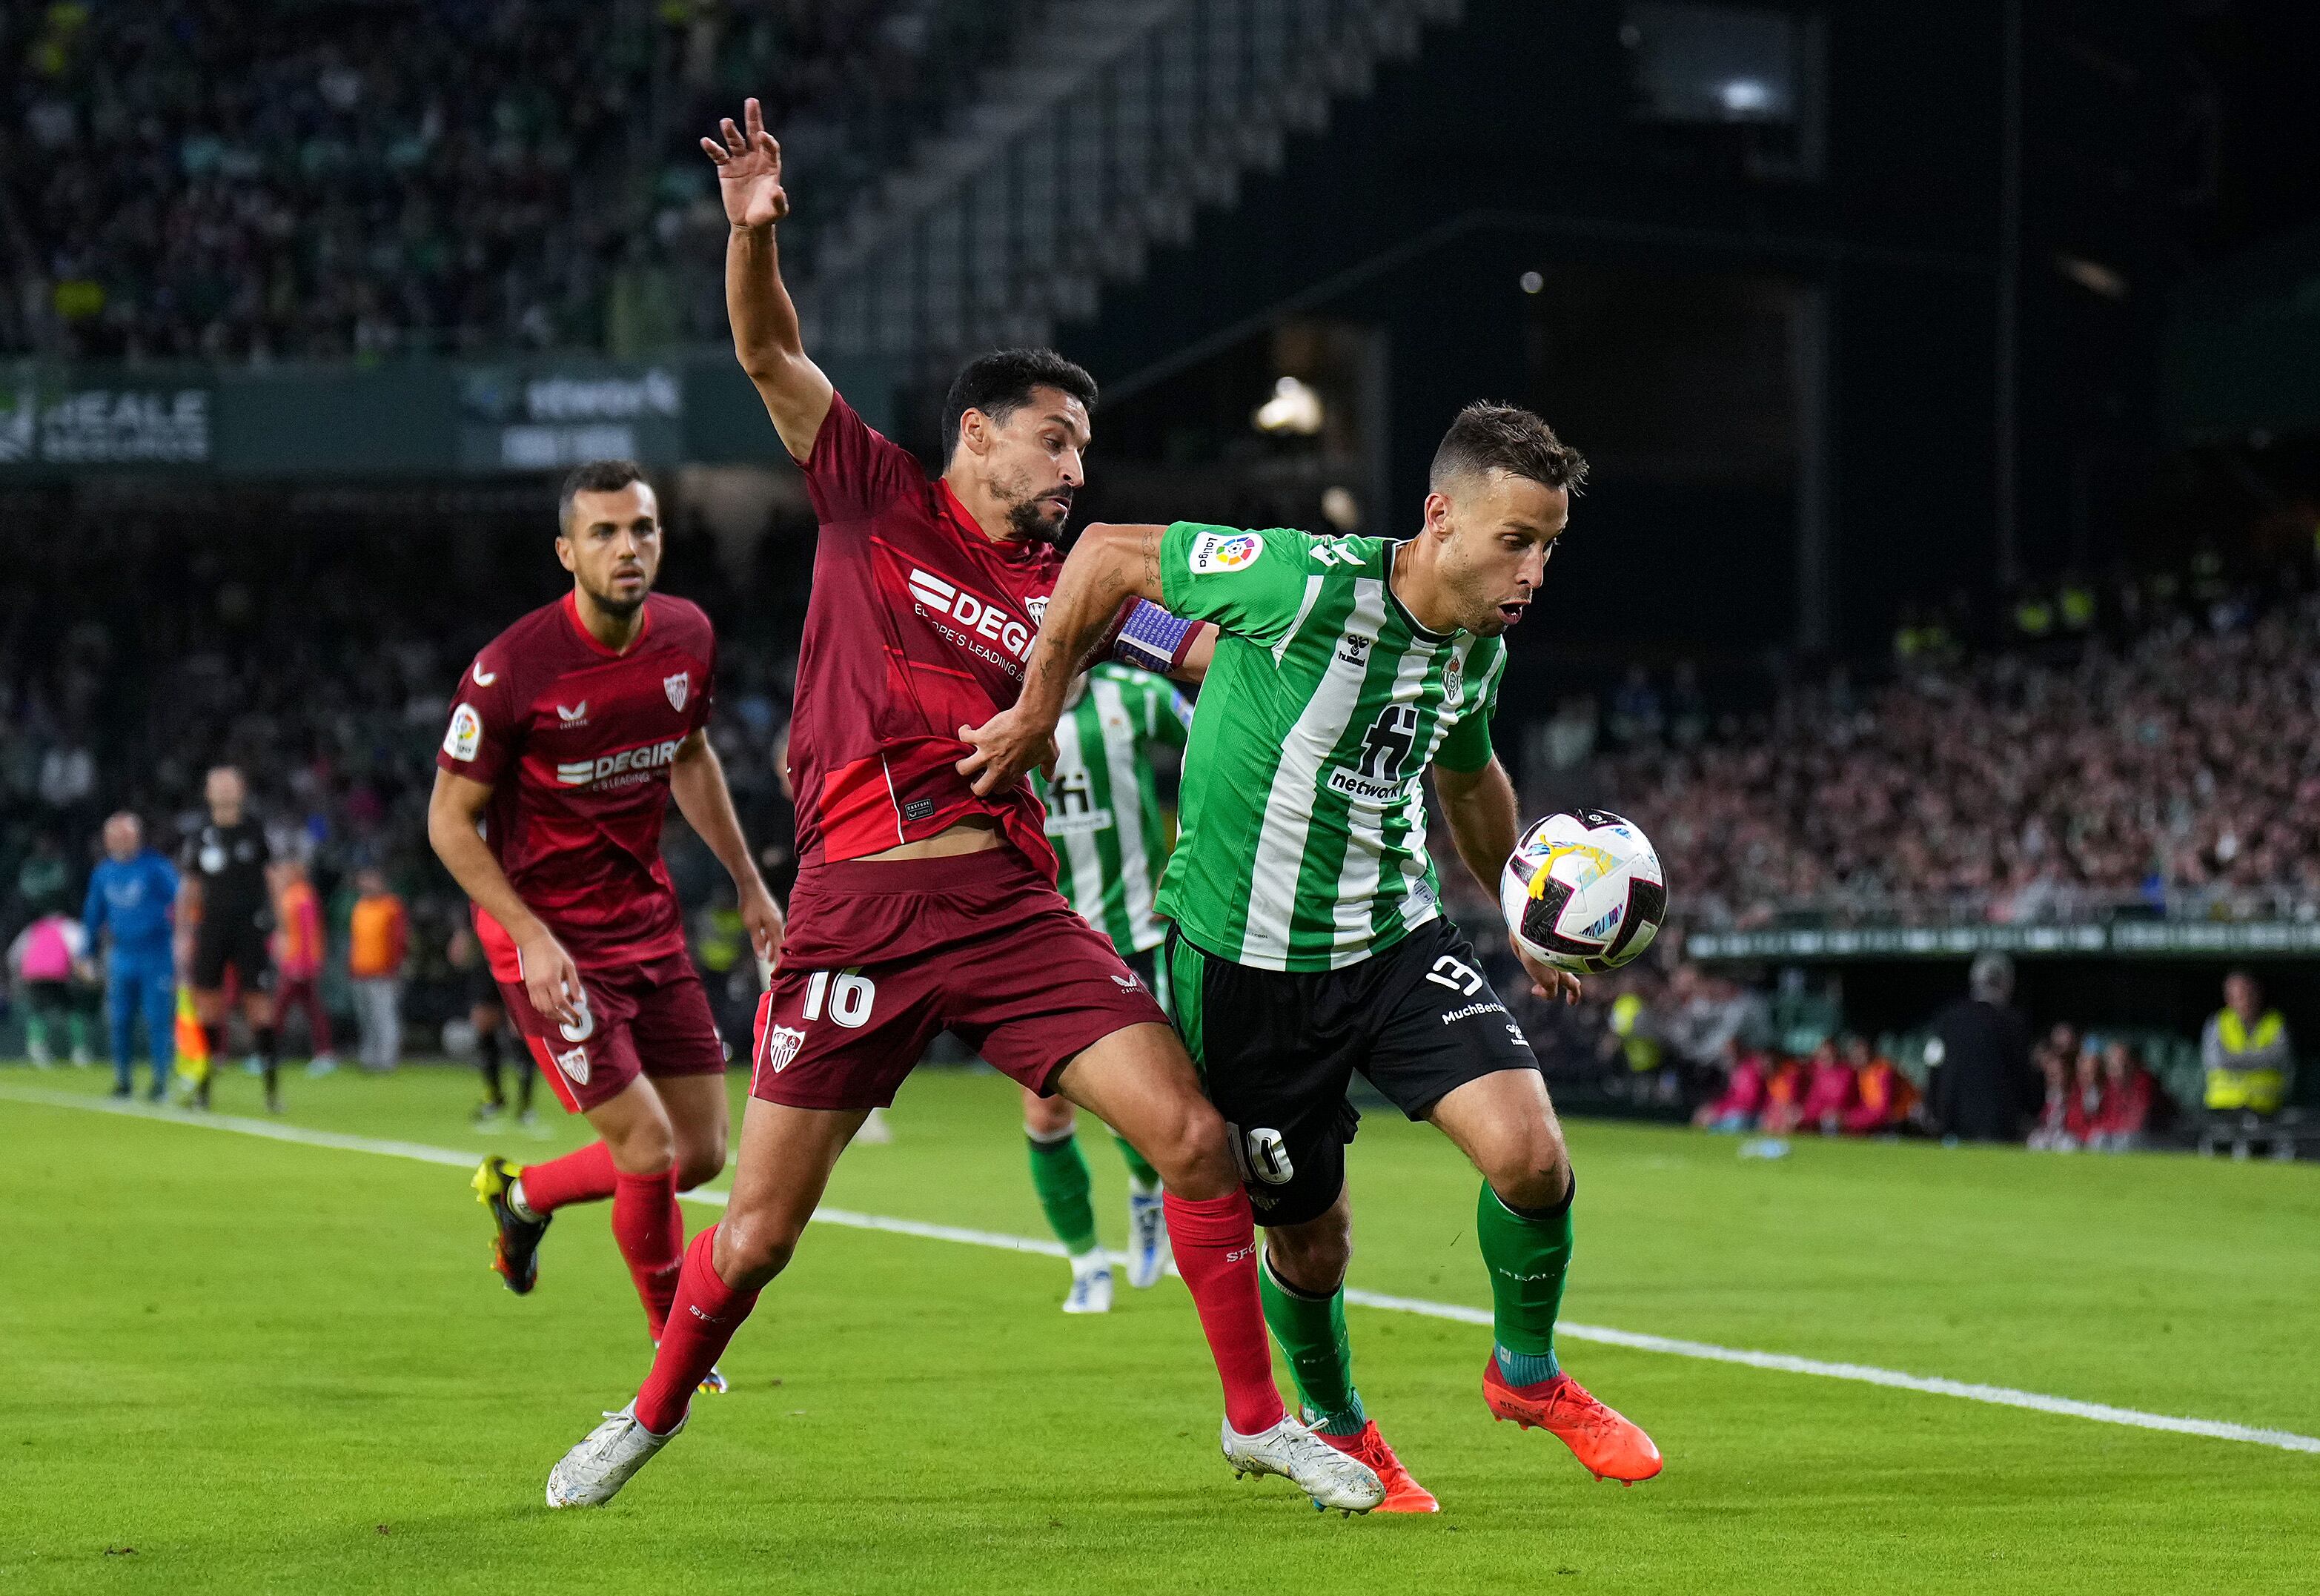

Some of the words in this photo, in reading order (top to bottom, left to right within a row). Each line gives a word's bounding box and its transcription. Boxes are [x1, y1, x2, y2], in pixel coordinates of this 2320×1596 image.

[1199, 537, 1218, 567] LaLiga
[968, 640, 1017, 675] LEADING
[1338, 651, 1365, 667] hummel
[1332, 773, 1400, 799] network
[802, 967, 875, 1028] 16
